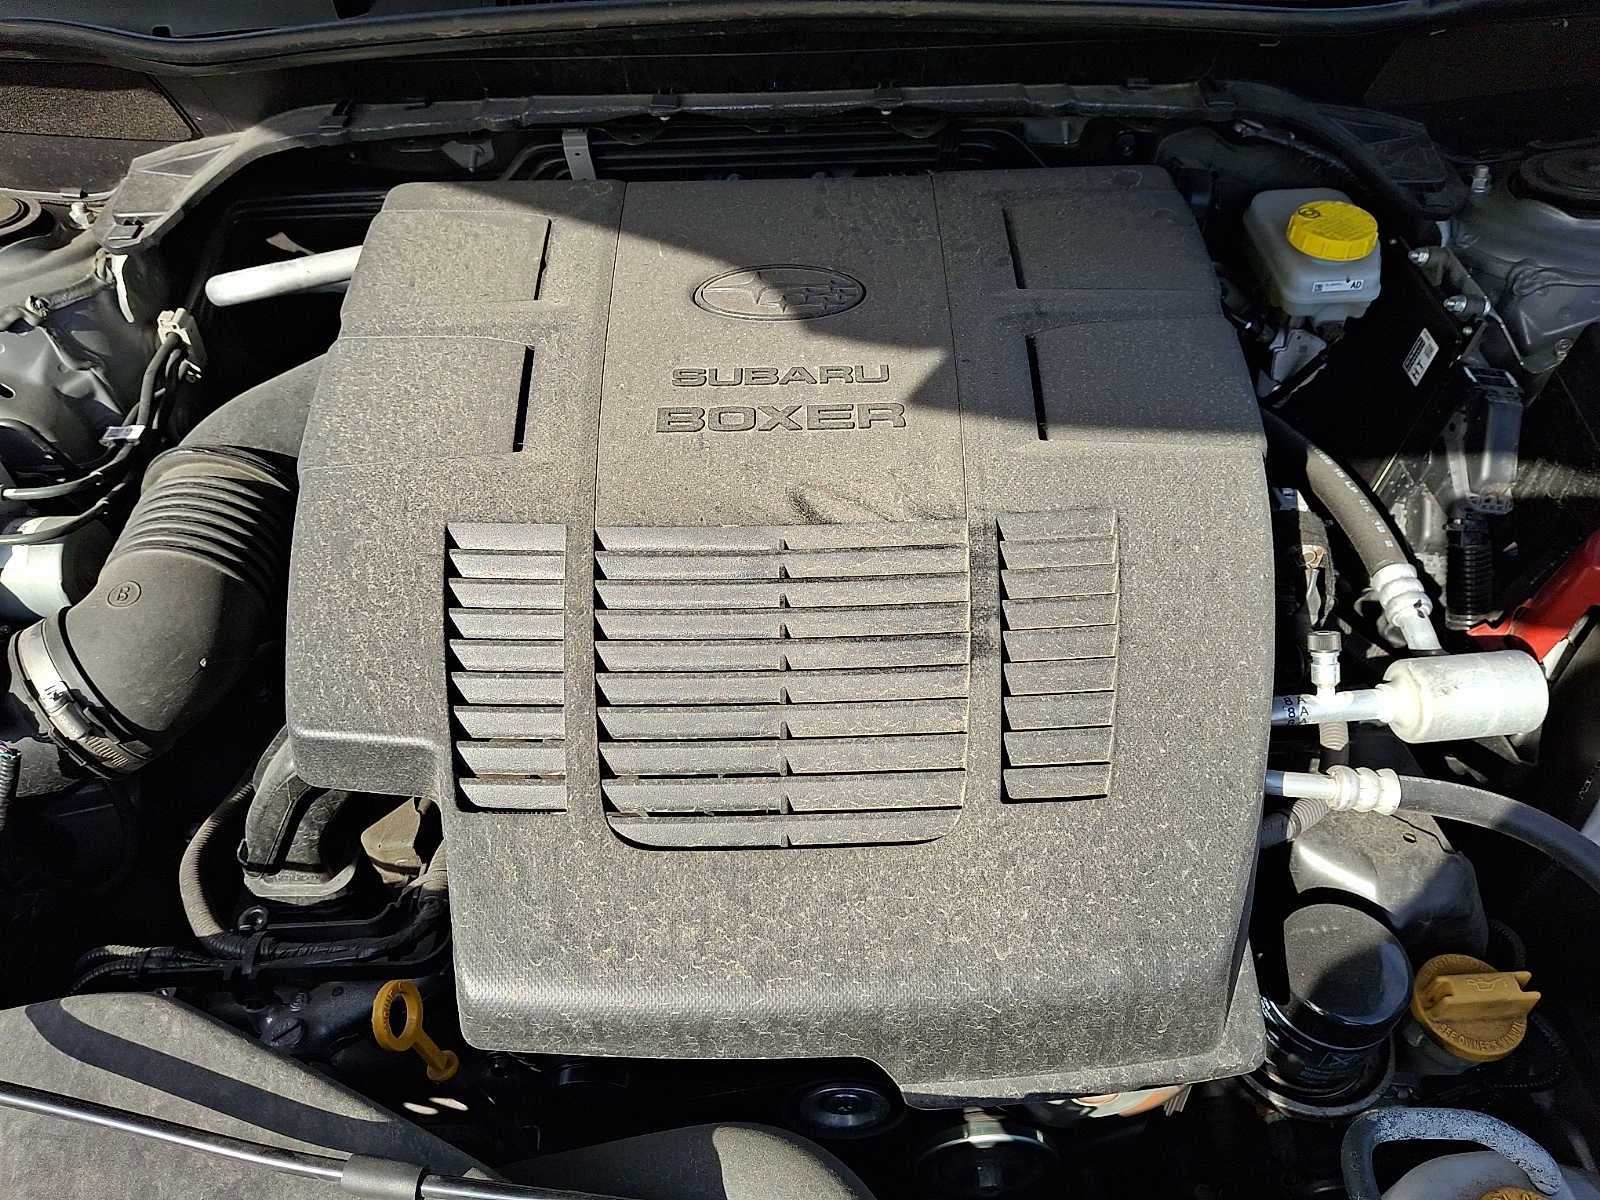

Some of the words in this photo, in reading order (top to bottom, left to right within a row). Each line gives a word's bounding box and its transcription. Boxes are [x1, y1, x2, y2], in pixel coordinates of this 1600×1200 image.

[1350, 281, 1362, 289] AD
[671, 364, 890, 387] SUBARU
[655, 402, 907, 433] BOXER
